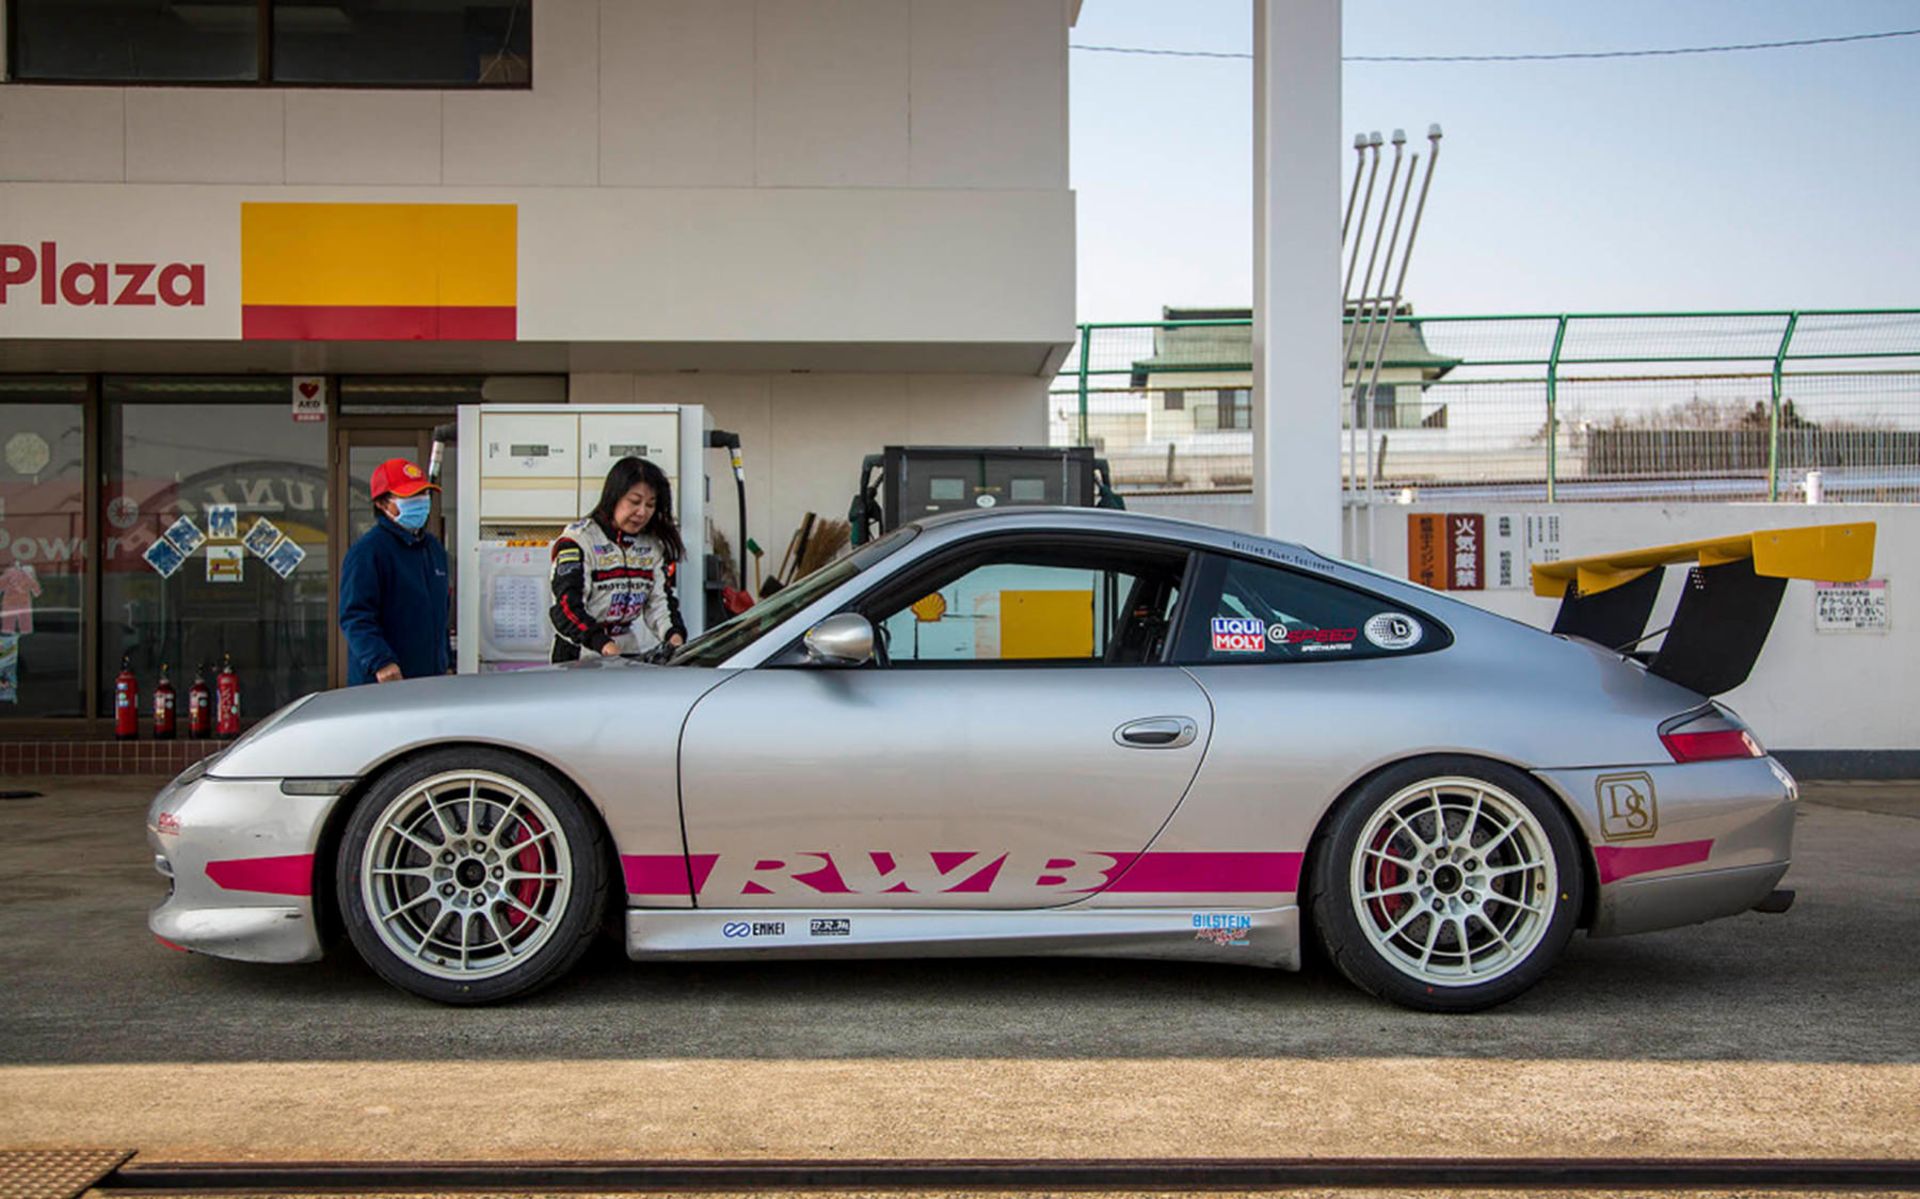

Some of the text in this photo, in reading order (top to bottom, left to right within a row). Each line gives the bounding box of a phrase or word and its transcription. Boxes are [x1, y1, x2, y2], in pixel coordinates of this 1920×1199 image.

[0, 241, 206, 306] Plaza
[1454, 517, 1476, 587] 火気厳禁
[1214, 620, 1263, 634] LIQUI
[1215, 635, 1264, 649] MOLY
[1607, 783, 1648, 829] DS
[700, 851, 1119, 895] RWB
[752, 922, 785, 936] ENKEI
[1192, 913, 1251, 928] BILSTEIN
